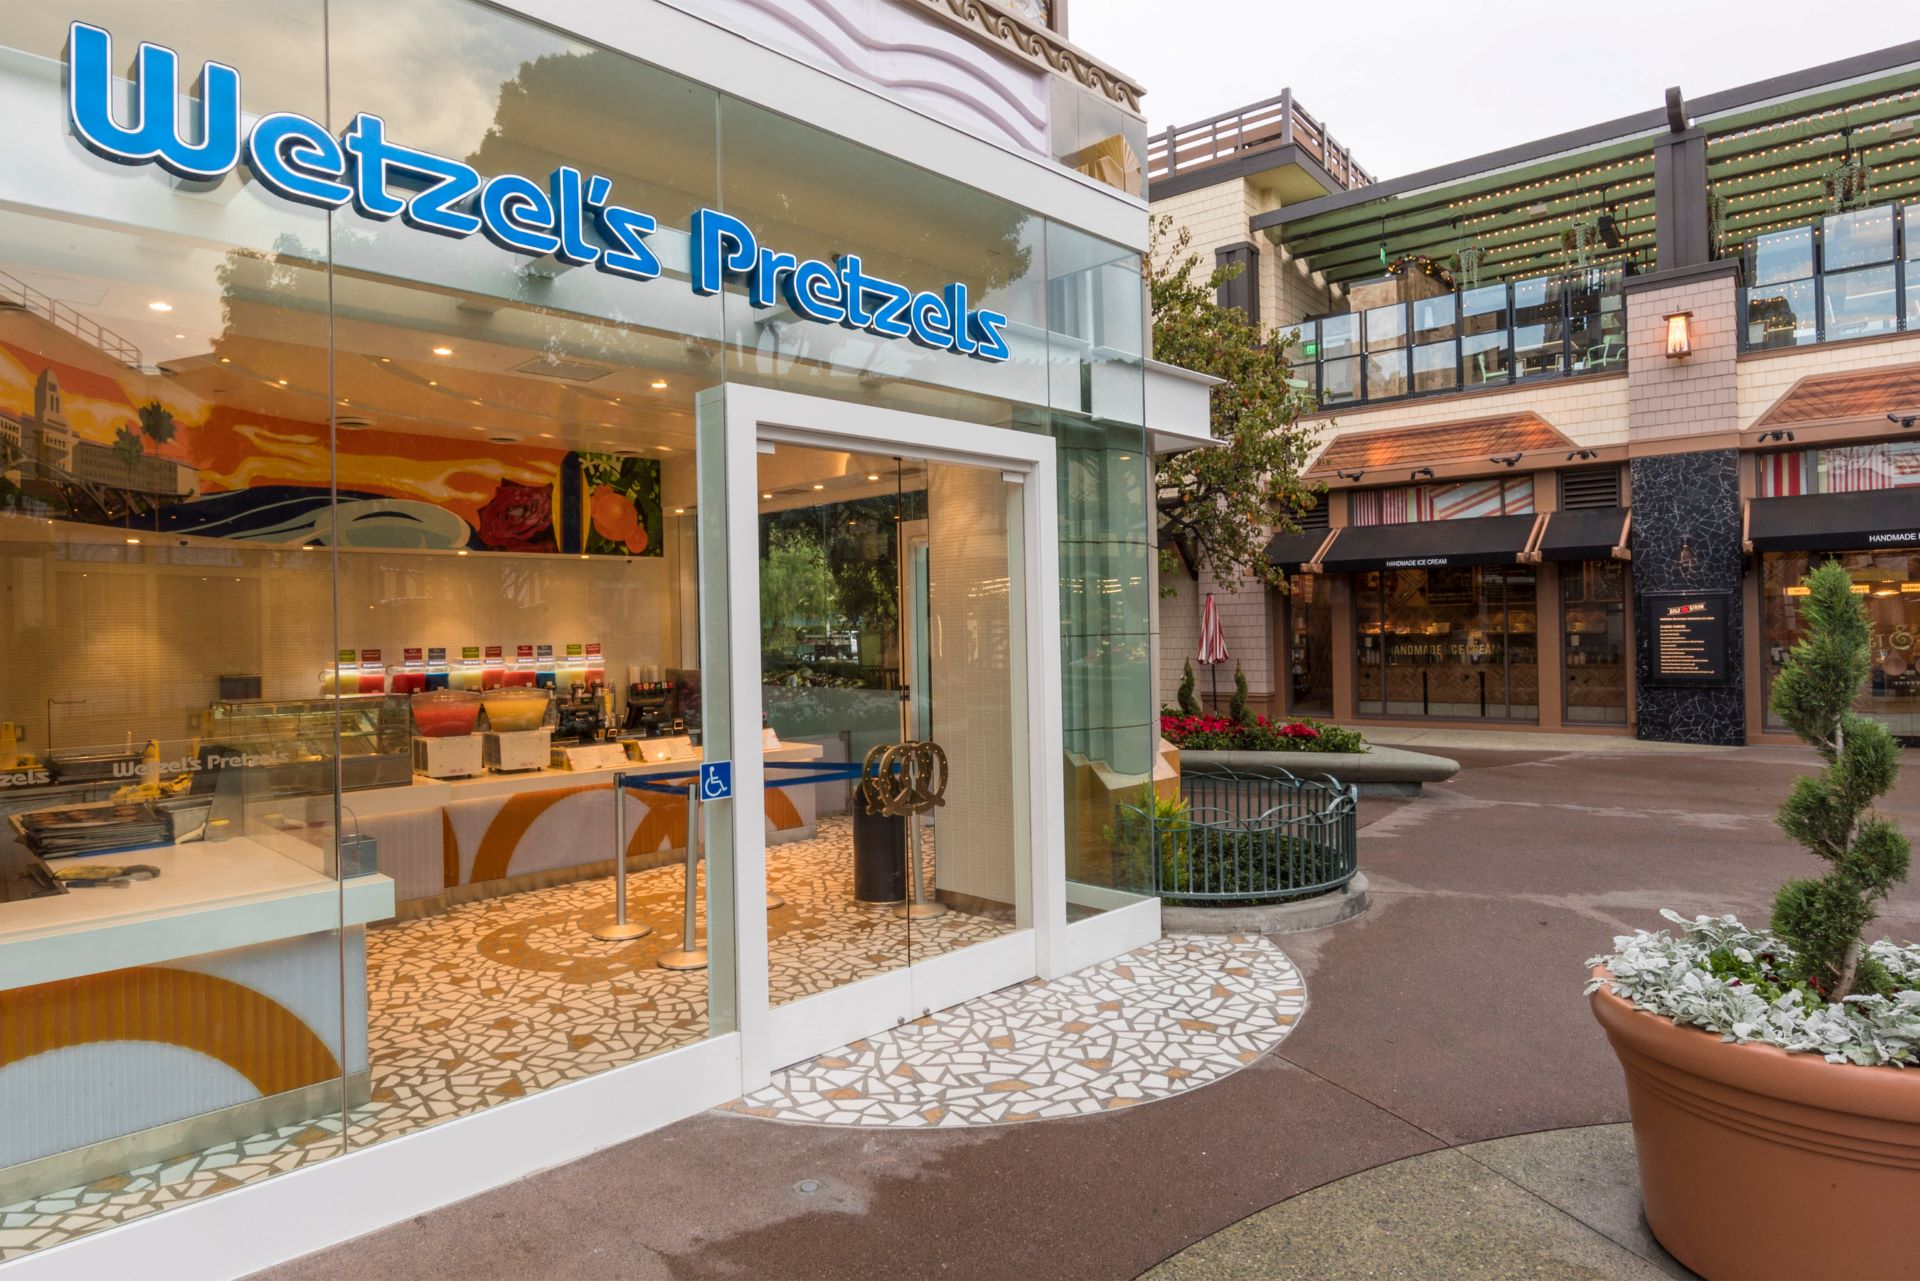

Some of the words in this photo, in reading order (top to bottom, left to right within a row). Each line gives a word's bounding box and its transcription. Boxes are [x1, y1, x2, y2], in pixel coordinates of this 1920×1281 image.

[66, 20, 661, 281] Wetzel's
[691, 207, 1011, 362] Pretzels
[1869, 533, 1917, 542] HANDMADE
[207, 752, 289, 770] Pretzels
